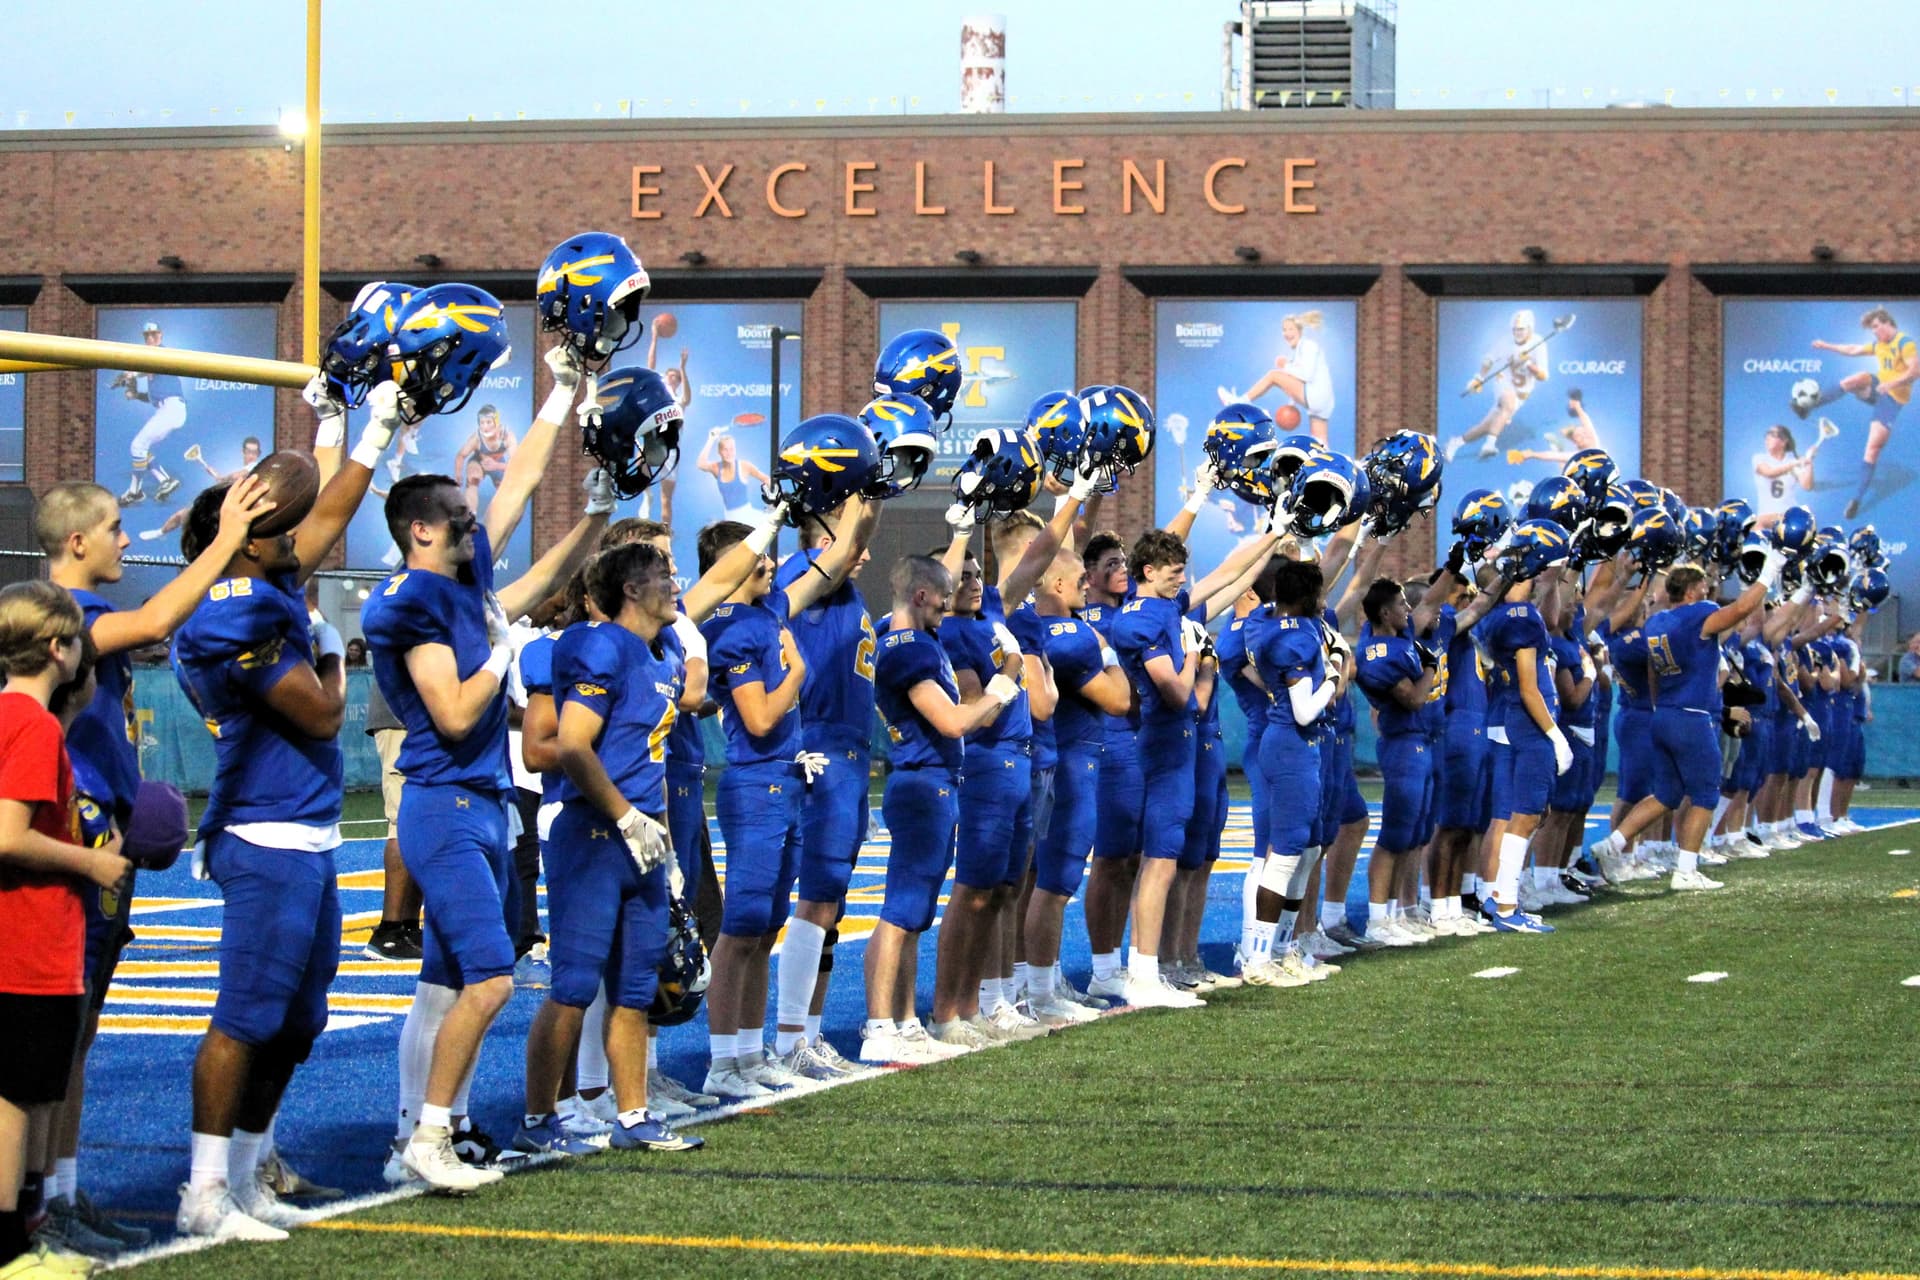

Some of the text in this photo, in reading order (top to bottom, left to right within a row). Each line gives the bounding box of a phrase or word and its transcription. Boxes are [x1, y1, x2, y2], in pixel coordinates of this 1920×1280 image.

[629, 157, 1318, 220] EXCELLENCE
[1558, 360, 1627, 375] COURAGE
[1743, 359, 1823, 374] CHARACTER
[1770, 479, 1785, 499] 6
[209, 576, 254, 602] 62
[383, 572, 410, 596] 7
[1647, 633, 1682, 677] 51
